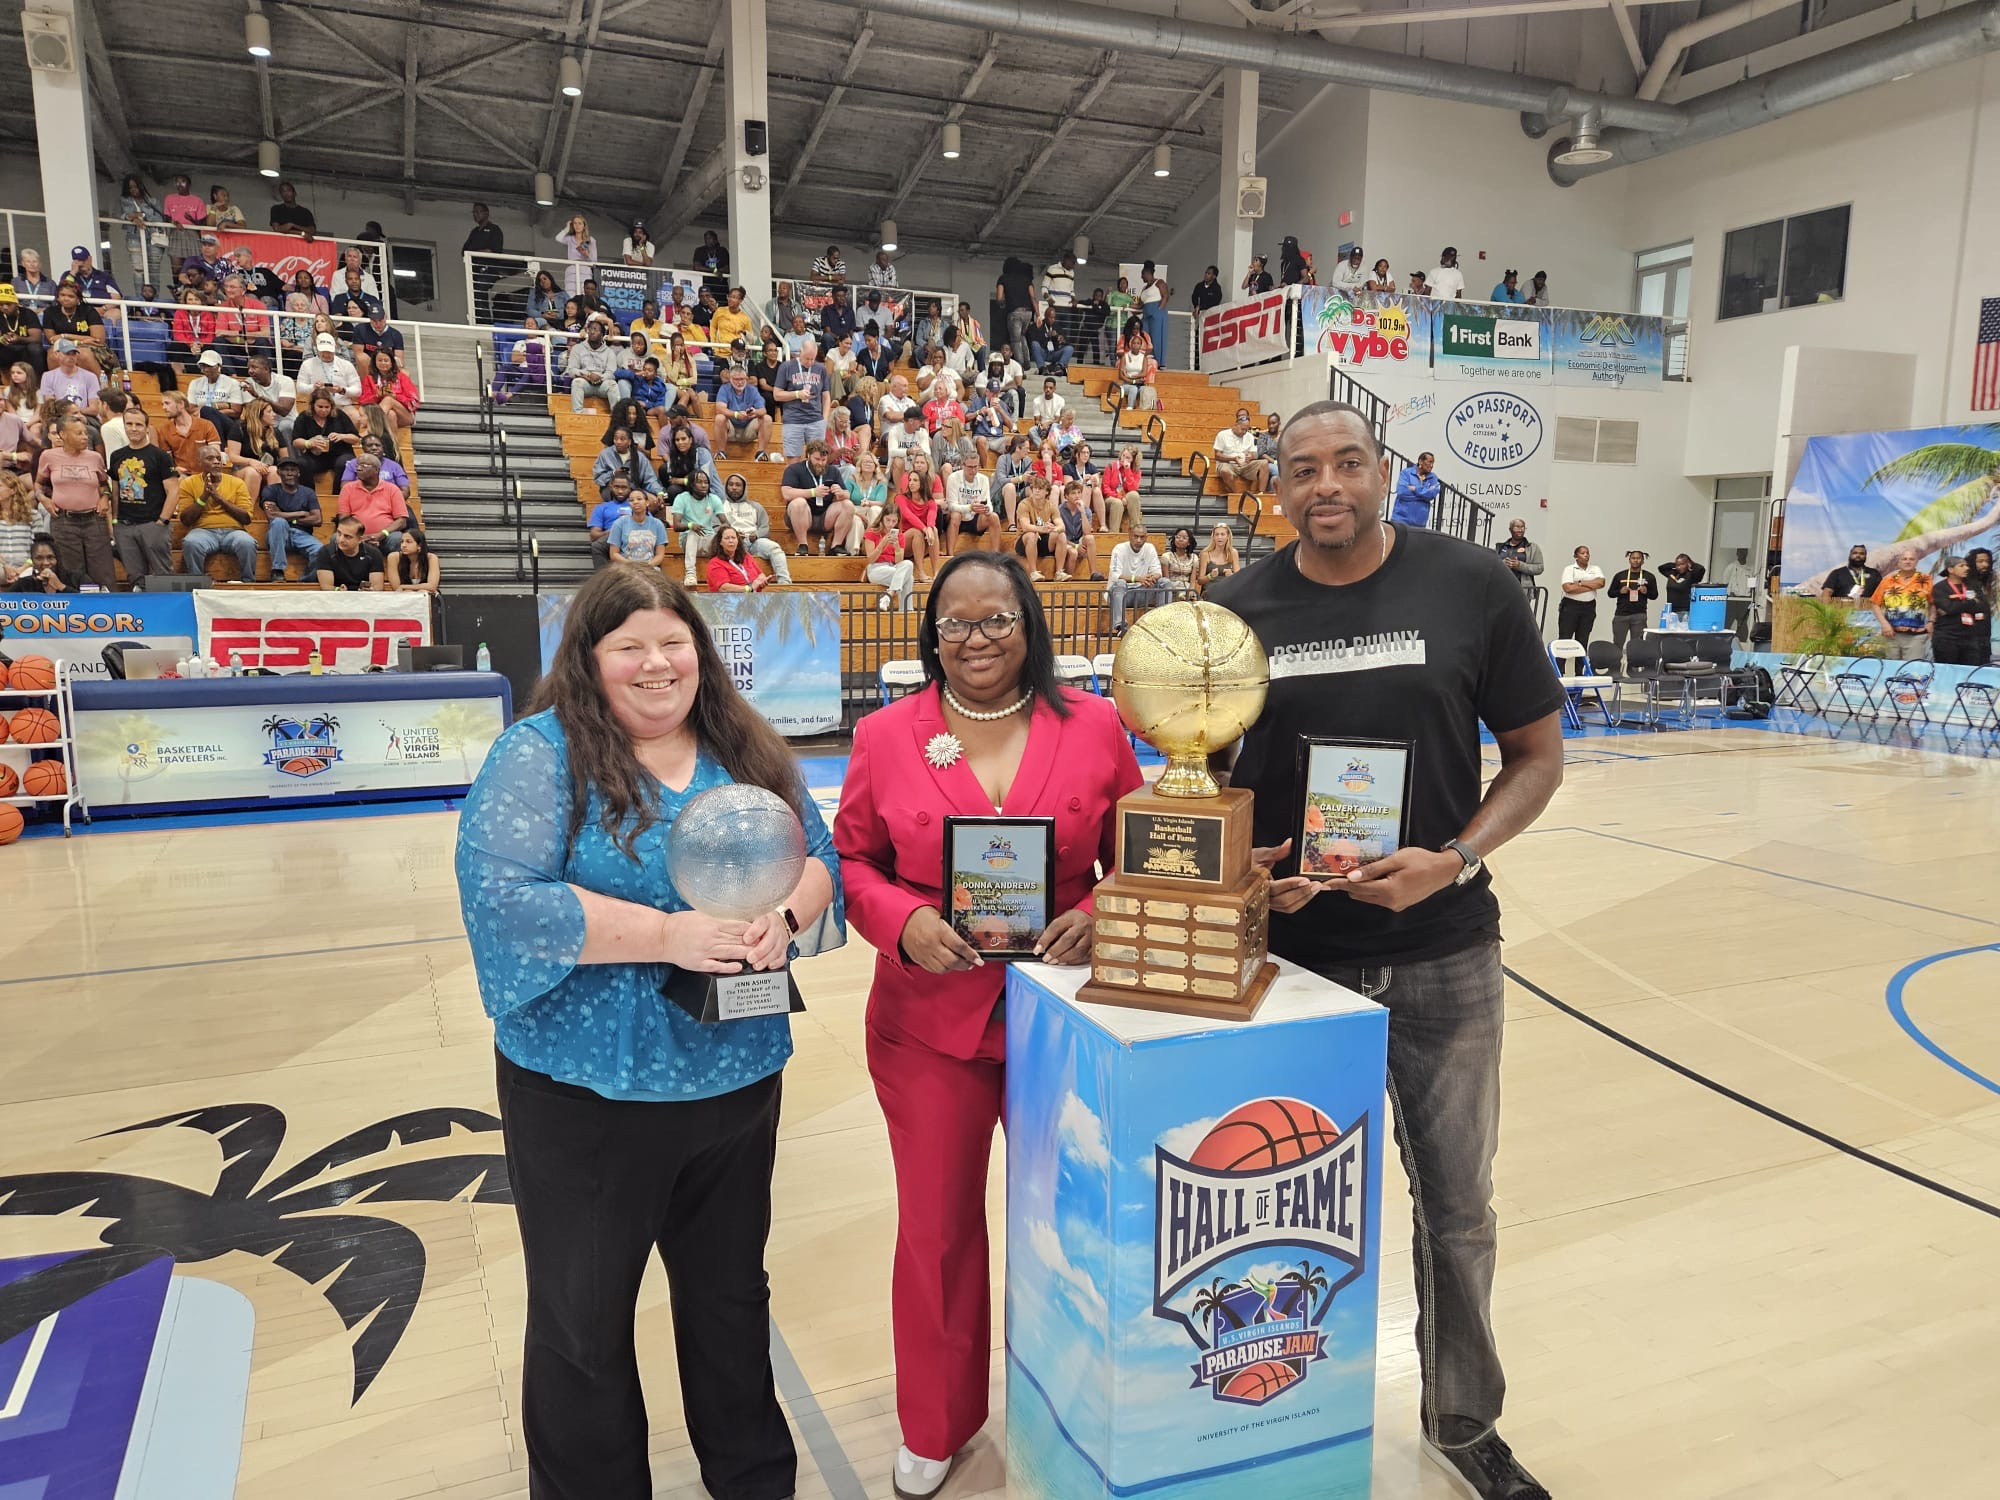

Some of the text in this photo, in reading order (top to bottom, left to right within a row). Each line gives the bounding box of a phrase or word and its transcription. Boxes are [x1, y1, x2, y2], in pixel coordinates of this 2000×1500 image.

[601, 269, 647, 280] POWERADE
[601, 280, 647, 290] NOW WITH
[604, 287, 645, 300] 50%
[1351, 307, 1376, 326] Da
[1202, 295, 1283, 353] ESPN
[1498, 332, 1532, 347] Bank
[1460, 365, 1495, 377] Together
[1497, 369, 1510, 377] we
[1511, 369, 1524, 378] are
[1456, 398, 1536, 428] NO PASSPORT
[1464, 440, 1523, 464] REQUIRED
[1465, 483, 1522, 496] ISLANDS
[22, 599, 37, 609] to
[43, 600, 68, 609] our
[211, 617, 423, 667] ESPN
[1273, 629, 1419, 665] PSYCHO BUNNY
[768, 715, 834, 725] families, and fans!
[403, 728, 438, 736] UNITED
[404, 735, 439, 744] STATES
[157, 744, 224, 755] BASKETBALL
[404, 744, 440, 752] VIRGIN
[158, 754, 215, 764] TRAVELERS
[1320, 803, 1390, 815] CALVERT WHITE
[1153, 823, 1192, 834] Basketball
[1149, 831, 1197, 843] Hall of Fame
[962, 881, 1036, 890] DONNA ANDREWS
[1167, 1144, 1356, 1278] HALL OF FAME
[1268, 1321, 1300, 1333] ISLANDS
[1197, 1407, 1320, 1443] UNIVERSITY OF THE VIRGIN ISLANDS
